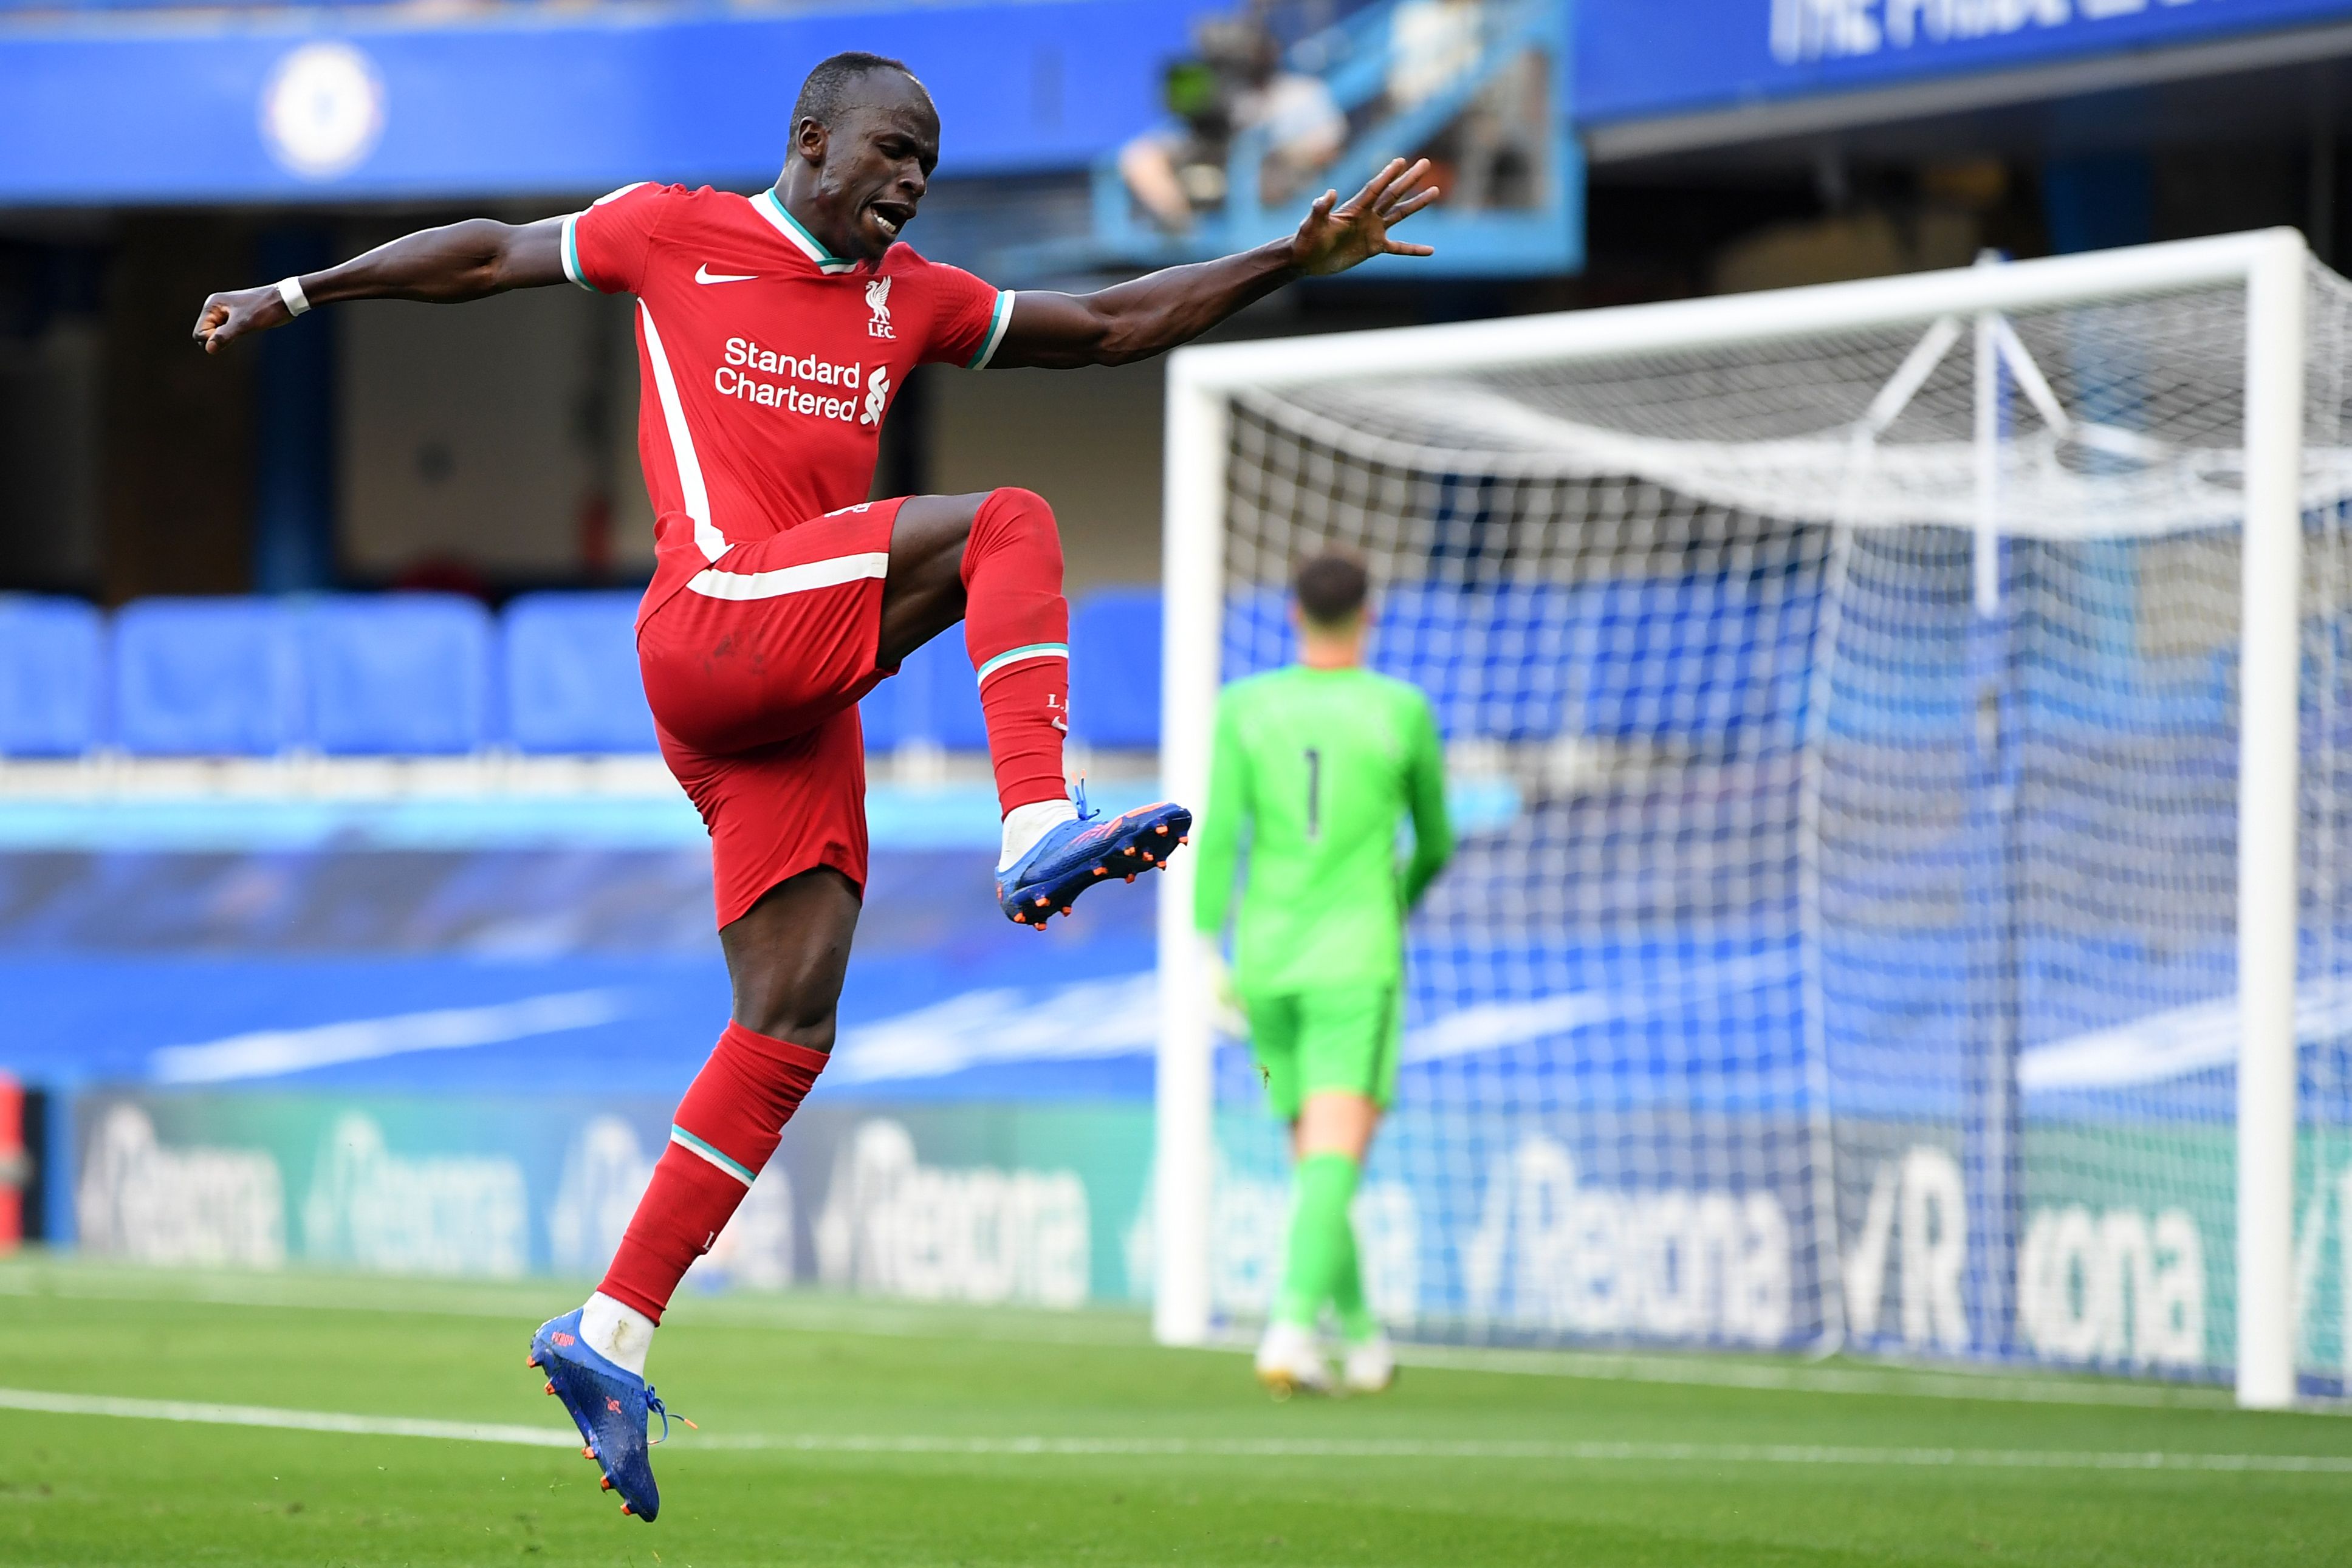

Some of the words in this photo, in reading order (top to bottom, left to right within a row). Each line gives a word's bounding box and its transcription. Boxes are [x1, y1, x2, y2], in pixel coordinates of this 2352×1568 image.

[724, 337, 860, 389] Standard
[714, 366, 859, 422] Chartered
[1304, 749, 1318, 841] 1
